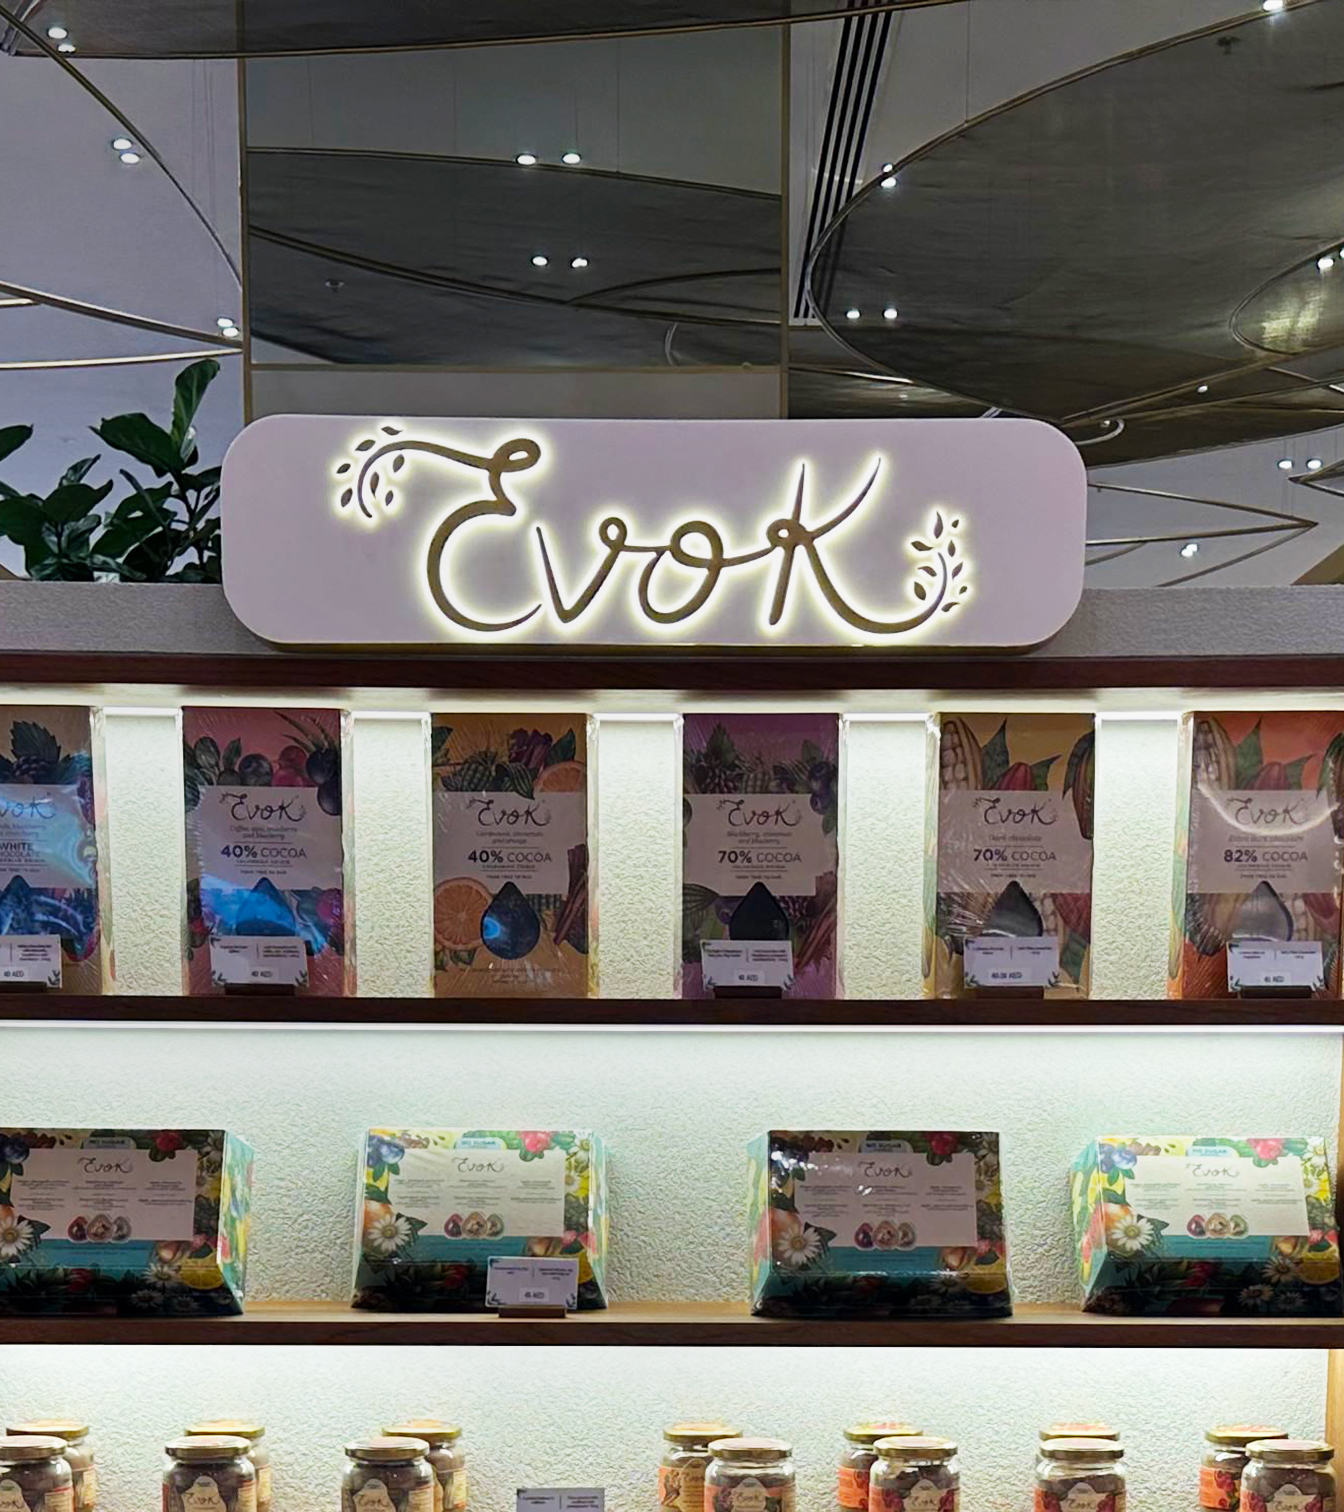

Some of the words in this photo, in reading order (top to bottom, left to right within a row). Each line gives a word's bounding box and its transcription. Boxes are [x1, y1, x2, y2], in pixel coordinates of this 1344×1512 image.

[221, 845, 258, 859] 40%
[260, 847, 307, 859] COCOA
[468, 850, 504, 863] 40%
[506, 852, 552, 863] COCOA
[718, 850, 753, 864] 70%
[756, 852, 803, 863] COCOA
[973, 848, 1008, 862] 70%
[1011, 850, 1057, 862] COCOA
[1223, 849, 1258, 862] 82%
[1262, 851, 1309, 861] COCOA
